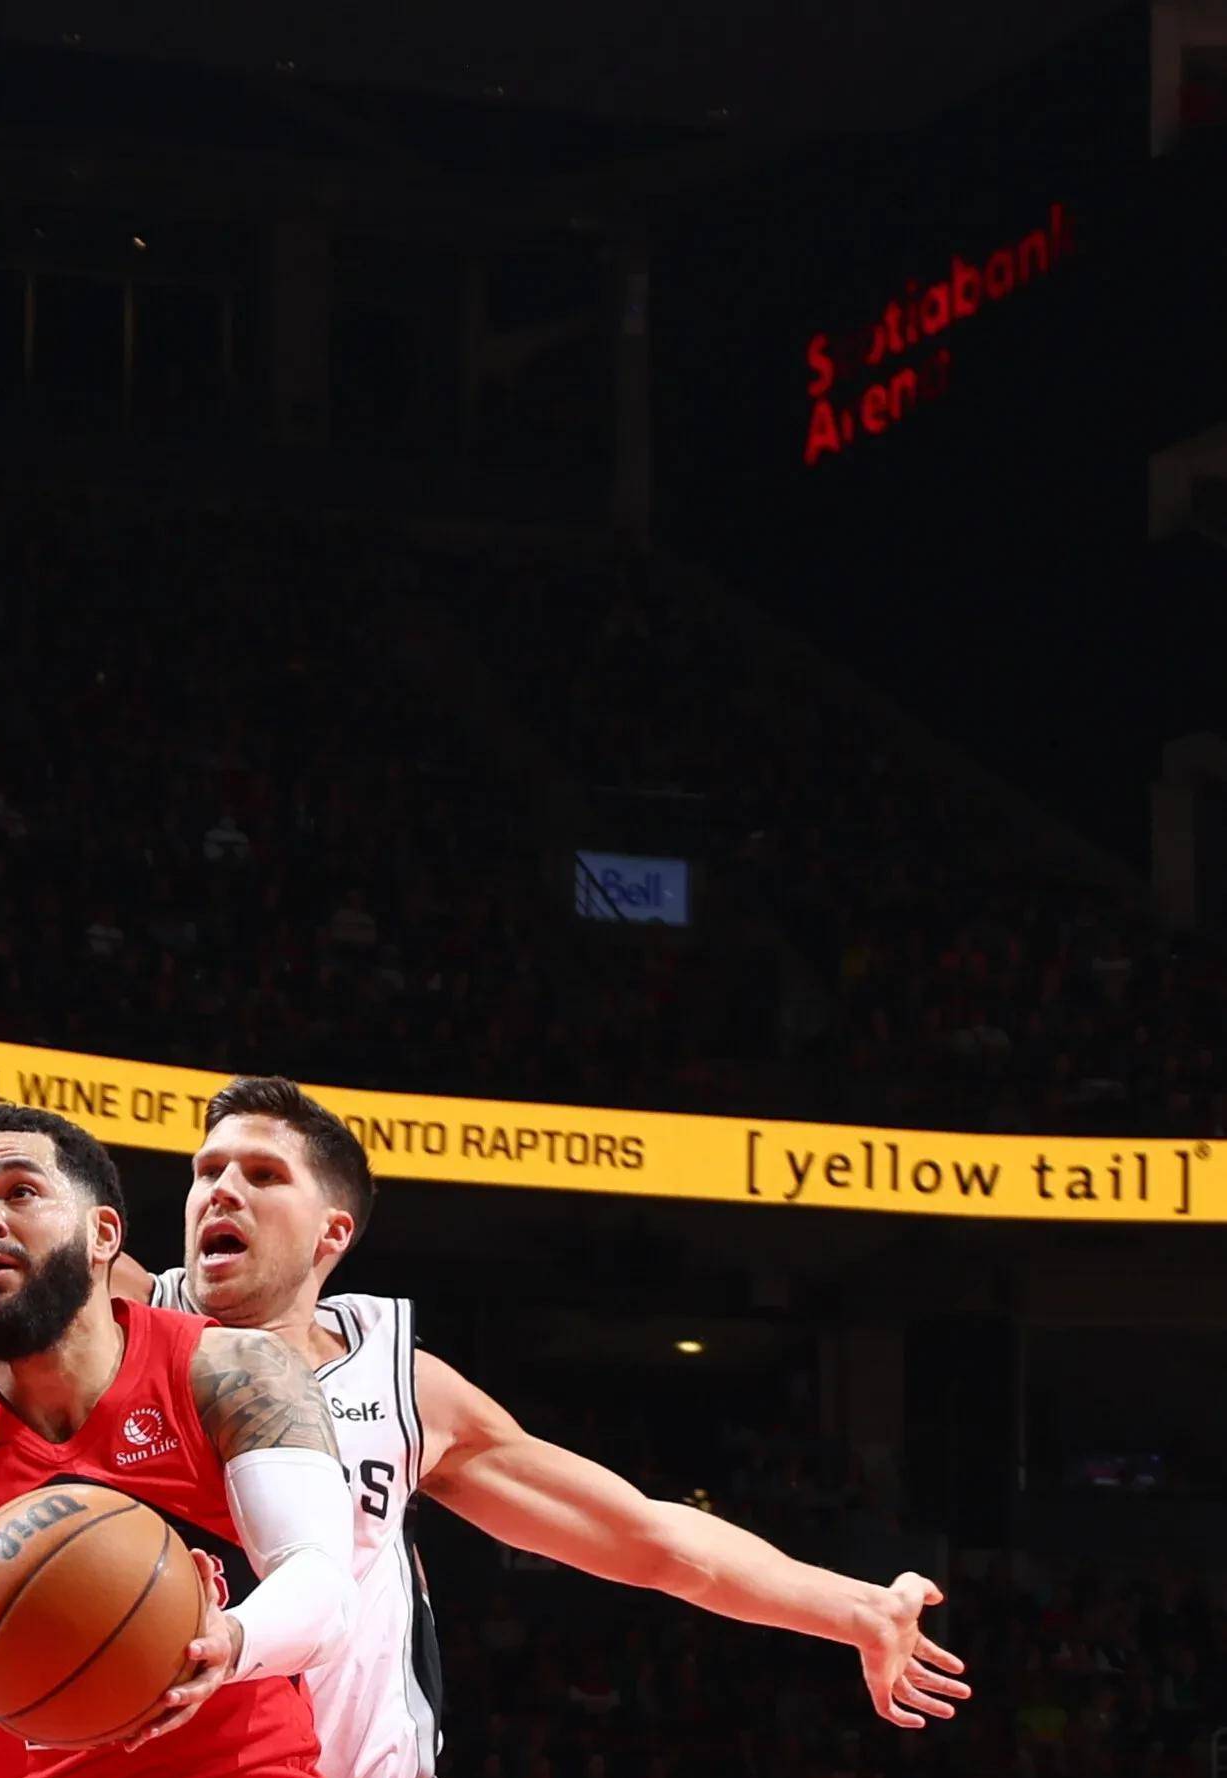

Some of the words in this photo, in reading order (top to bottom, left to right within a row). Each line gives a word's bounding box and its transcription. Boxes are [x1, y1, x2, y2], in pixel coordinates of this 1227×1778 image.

[600, 868, 661, 907] Bell
[19, 1070, 120, 1118] WINE
[131, 1087, 178, 1125] OF
[460, 1123, 645, 1170] RAPTORS
[330, 1397, 386, 1422] Self.
[115, 1449, 149, 1466] Sun
[151, 1437, 179, 1457] Life
